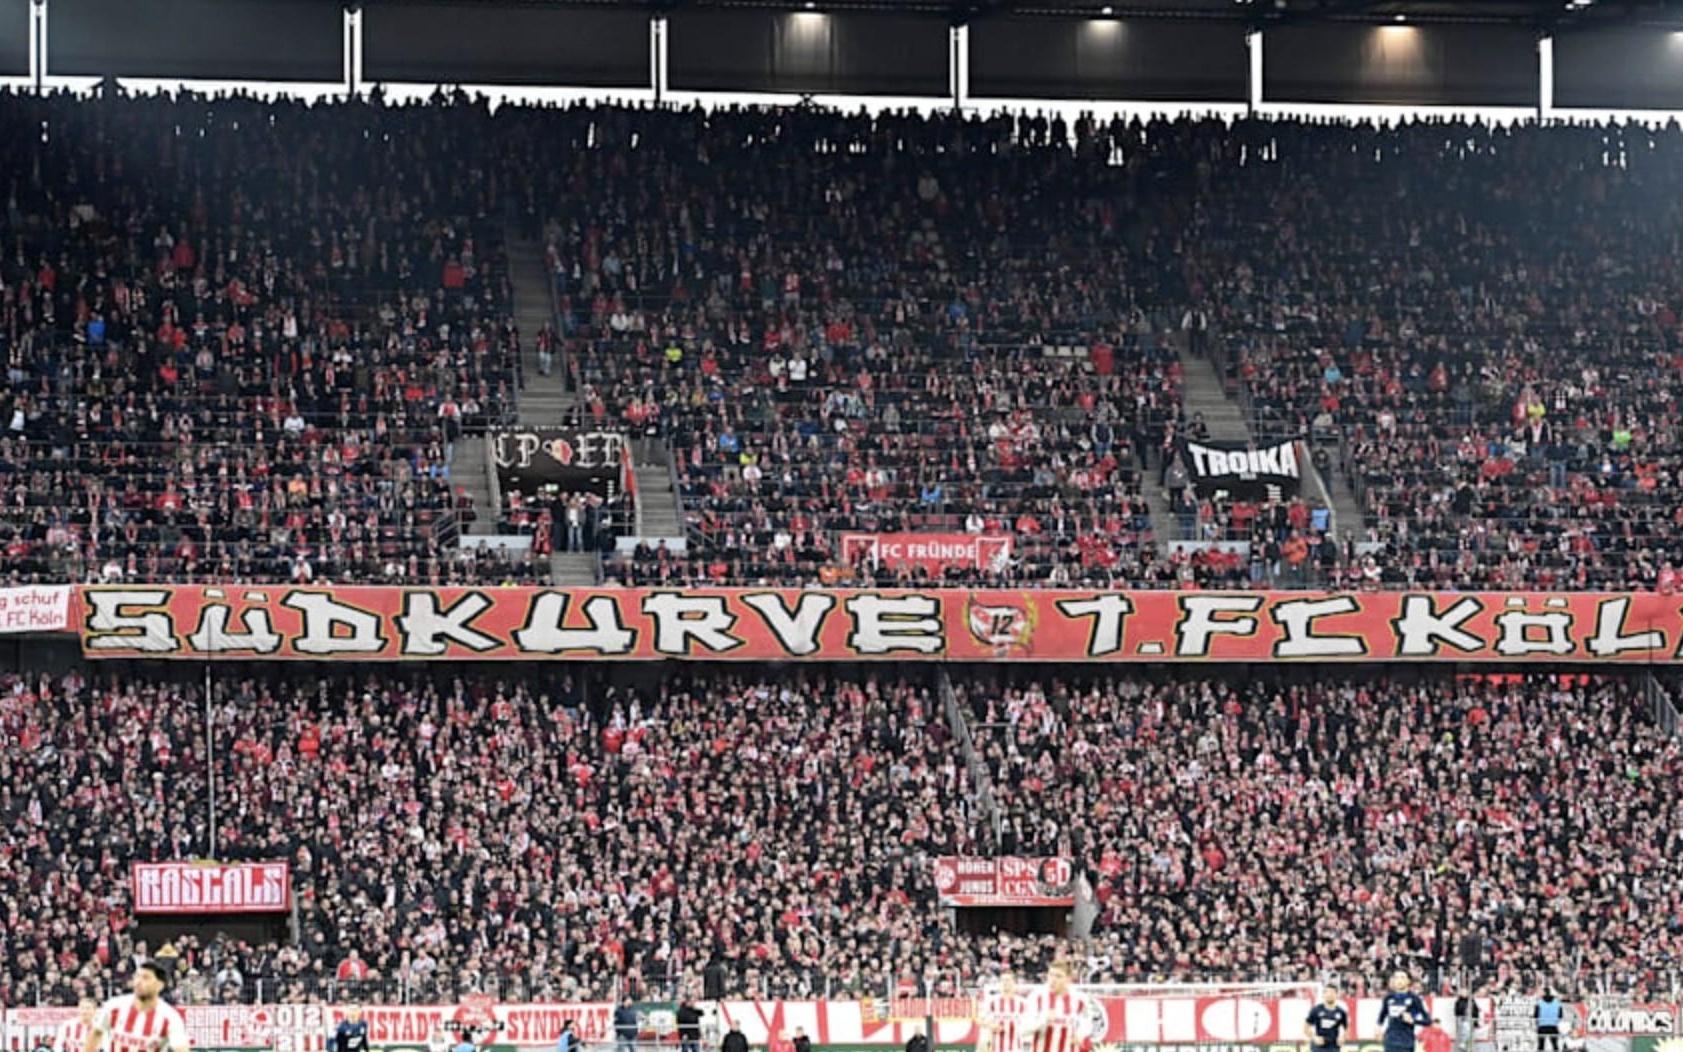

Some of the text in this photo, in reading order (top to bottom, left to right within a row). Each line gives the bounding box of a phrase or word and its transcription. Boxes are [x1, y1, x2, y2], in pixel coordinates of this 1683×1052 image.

[1188, 441, 1299, 478] TROIKA
[881, 540, 976, 559] FC FRÜNDE
[14, 590, 59, 606] schuf
[84, 589, 944, 655] SÜDKURVE
[991, 614, 1014, 635] 12
[1391, 594, 1683, 657] KÖL
[140, 867, 282, 906] RASCALS
